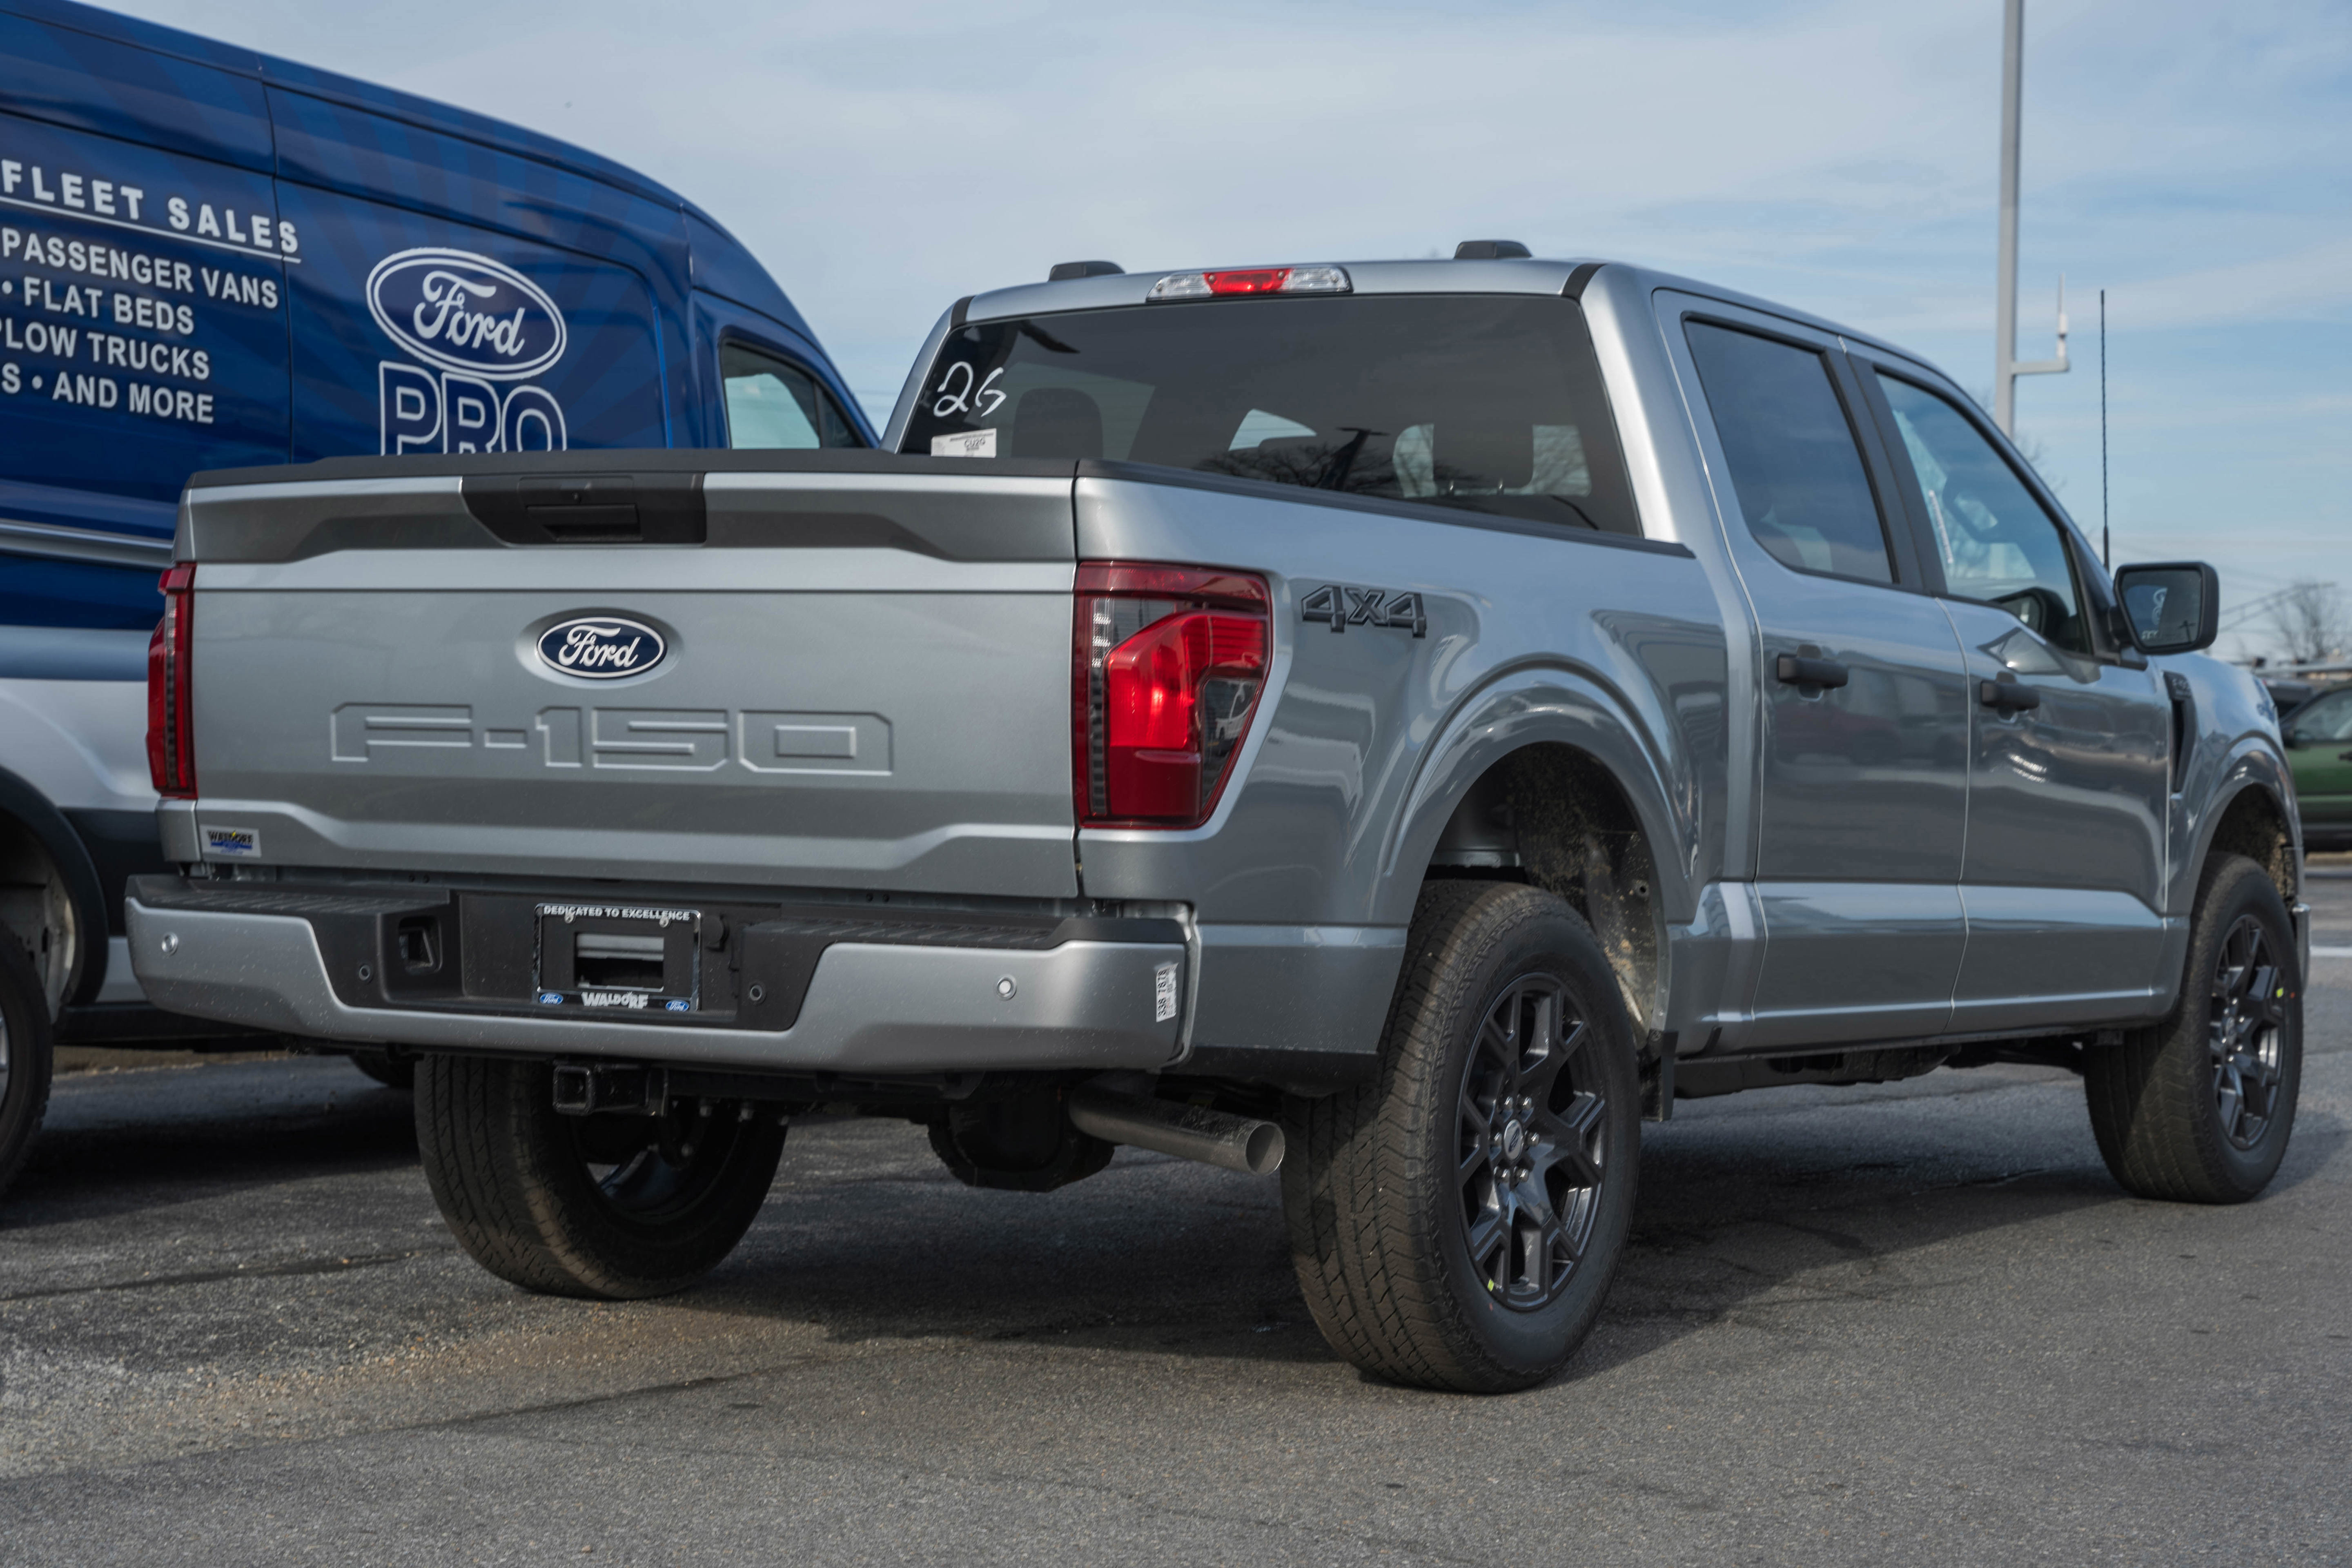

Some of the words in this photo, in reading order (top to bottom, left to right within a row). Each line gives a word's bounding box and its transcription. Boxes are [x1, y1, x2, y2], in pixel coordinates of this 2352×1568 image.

[1, 159, 143, 220] FLEET
[167, 197, 298, 253] SALES
[2, 227, 194, 293] PASSENGER
[201, 267, 278, 308] VANS
[24, 276, 102, 318] FLAT
[114, 293, 194, 335] BEDS
[413, 270, 525, 356] Ford
[0, 317, 77, 358] LOW
[87, 332, 210, 380] TRUCKS
[52, 371, 118, 408] AND
[129, 383, 214, 423] MORE
[379, 360, 567, 456] PRO
[558, 625, 641, 668] Ford
[331, 702, 893, 776] F-150
[543, 905, 602, 917] DEDICATED
[605, 908, 619, 918] TO
[622, 908, 690, 921] EXCELLENCE
[581, 991, 649, 1009] WALDORF
